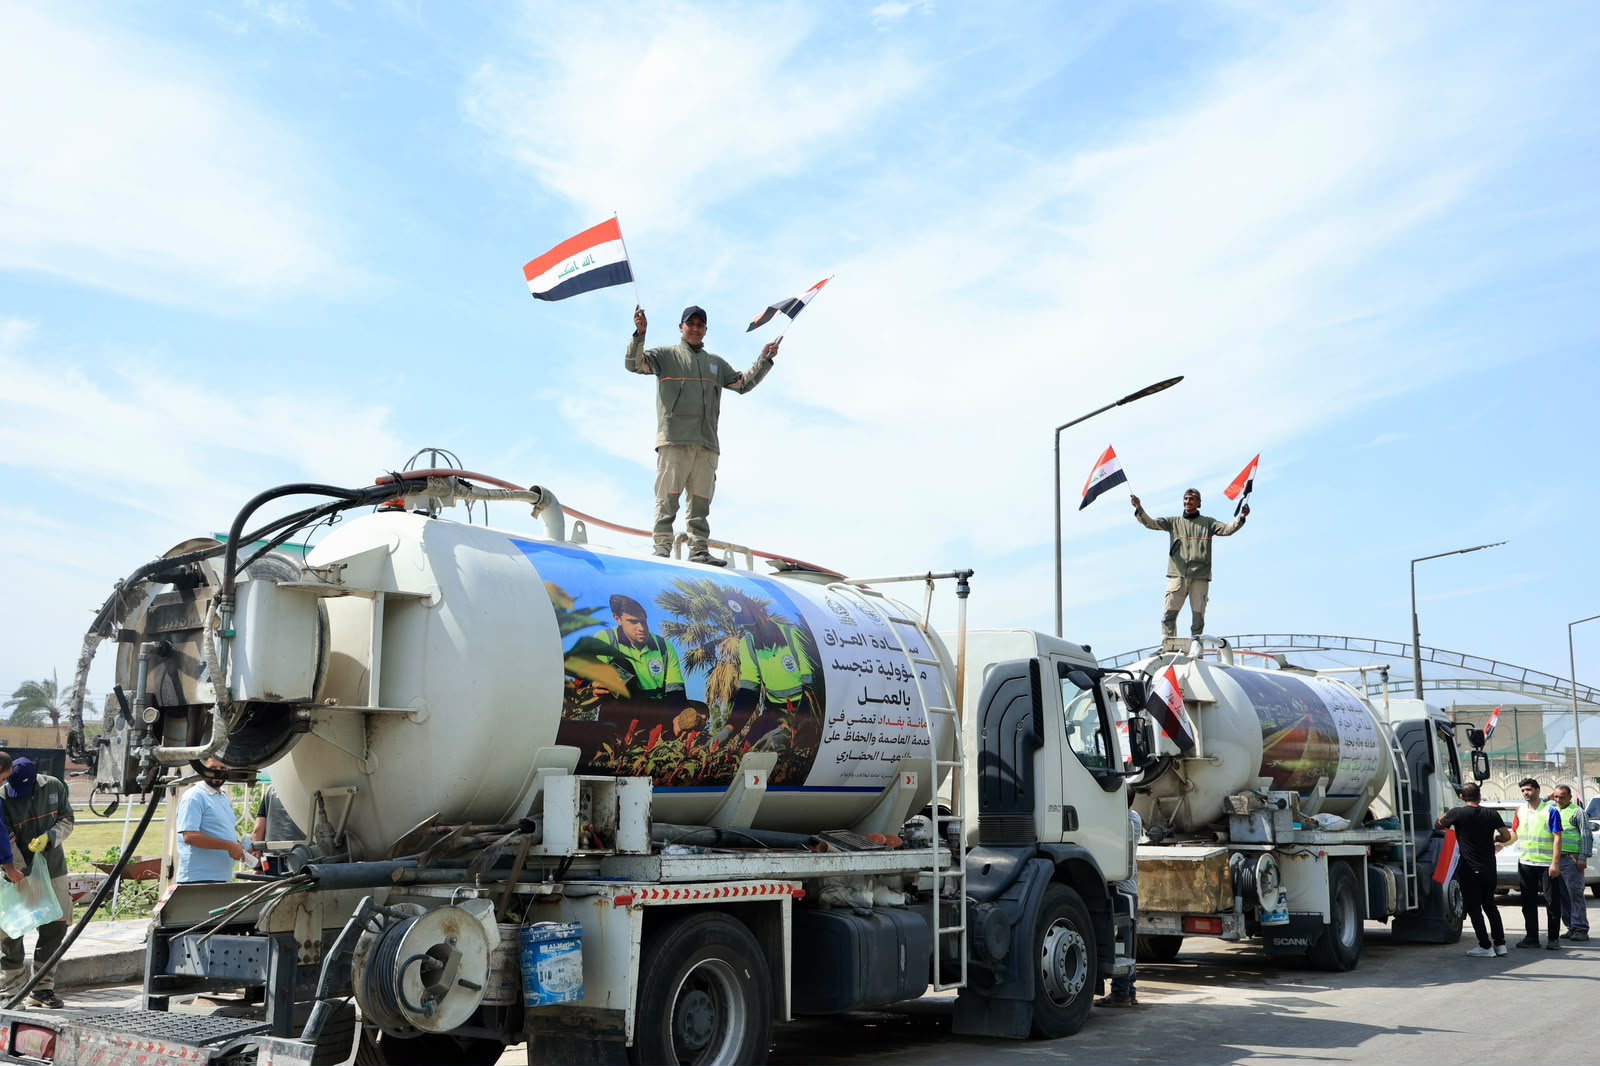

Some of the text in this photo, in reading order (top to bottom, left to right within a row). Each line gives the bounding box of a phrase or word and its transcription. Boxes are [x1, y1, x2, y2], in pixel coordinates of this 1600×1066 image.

[824, 629, 919, 655] سادة العراق
[831, 659, 874, 678] تتجسد
[857, 685, 911, 712] بالعمل
[828, 710, 846, 728] في
[846, 714, 876, 730] تمضي
[878, 714, 905, 730] بغداد
[824, 730, 840, 744] على
[843, 730, 876, 746] والحفاظ
[878, 732, 910, 746] العاصمة
[836, 750, 880, 764] الحضاري
